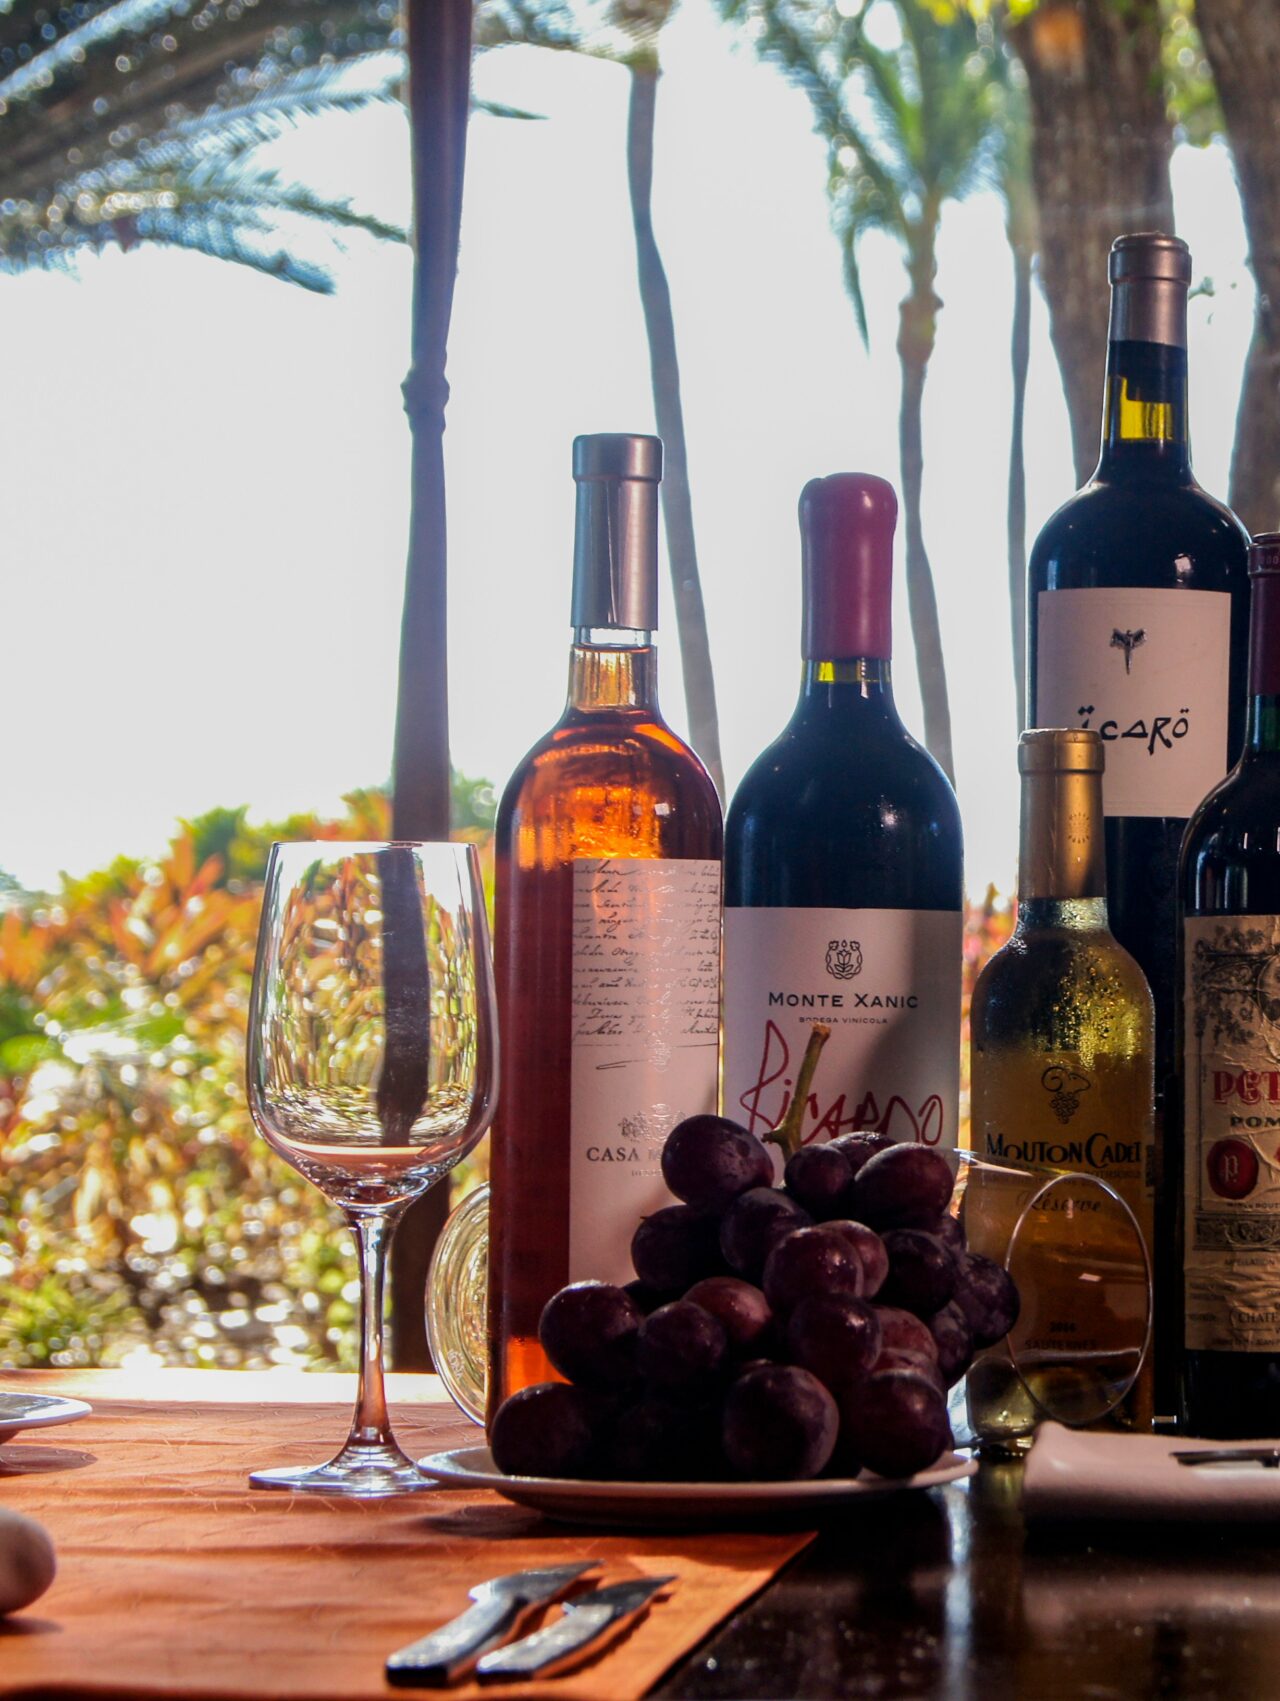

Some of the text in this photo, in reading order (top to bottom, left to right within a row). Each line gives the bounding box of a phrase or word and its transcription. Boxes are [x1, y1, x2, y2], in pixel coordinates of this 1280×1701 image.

[768, 991, 919, 1009] MONTE XANIC
[586, 1146, 641, 1163] CASA
[986, 1132, 1142, 1170] MOUTON CADET
